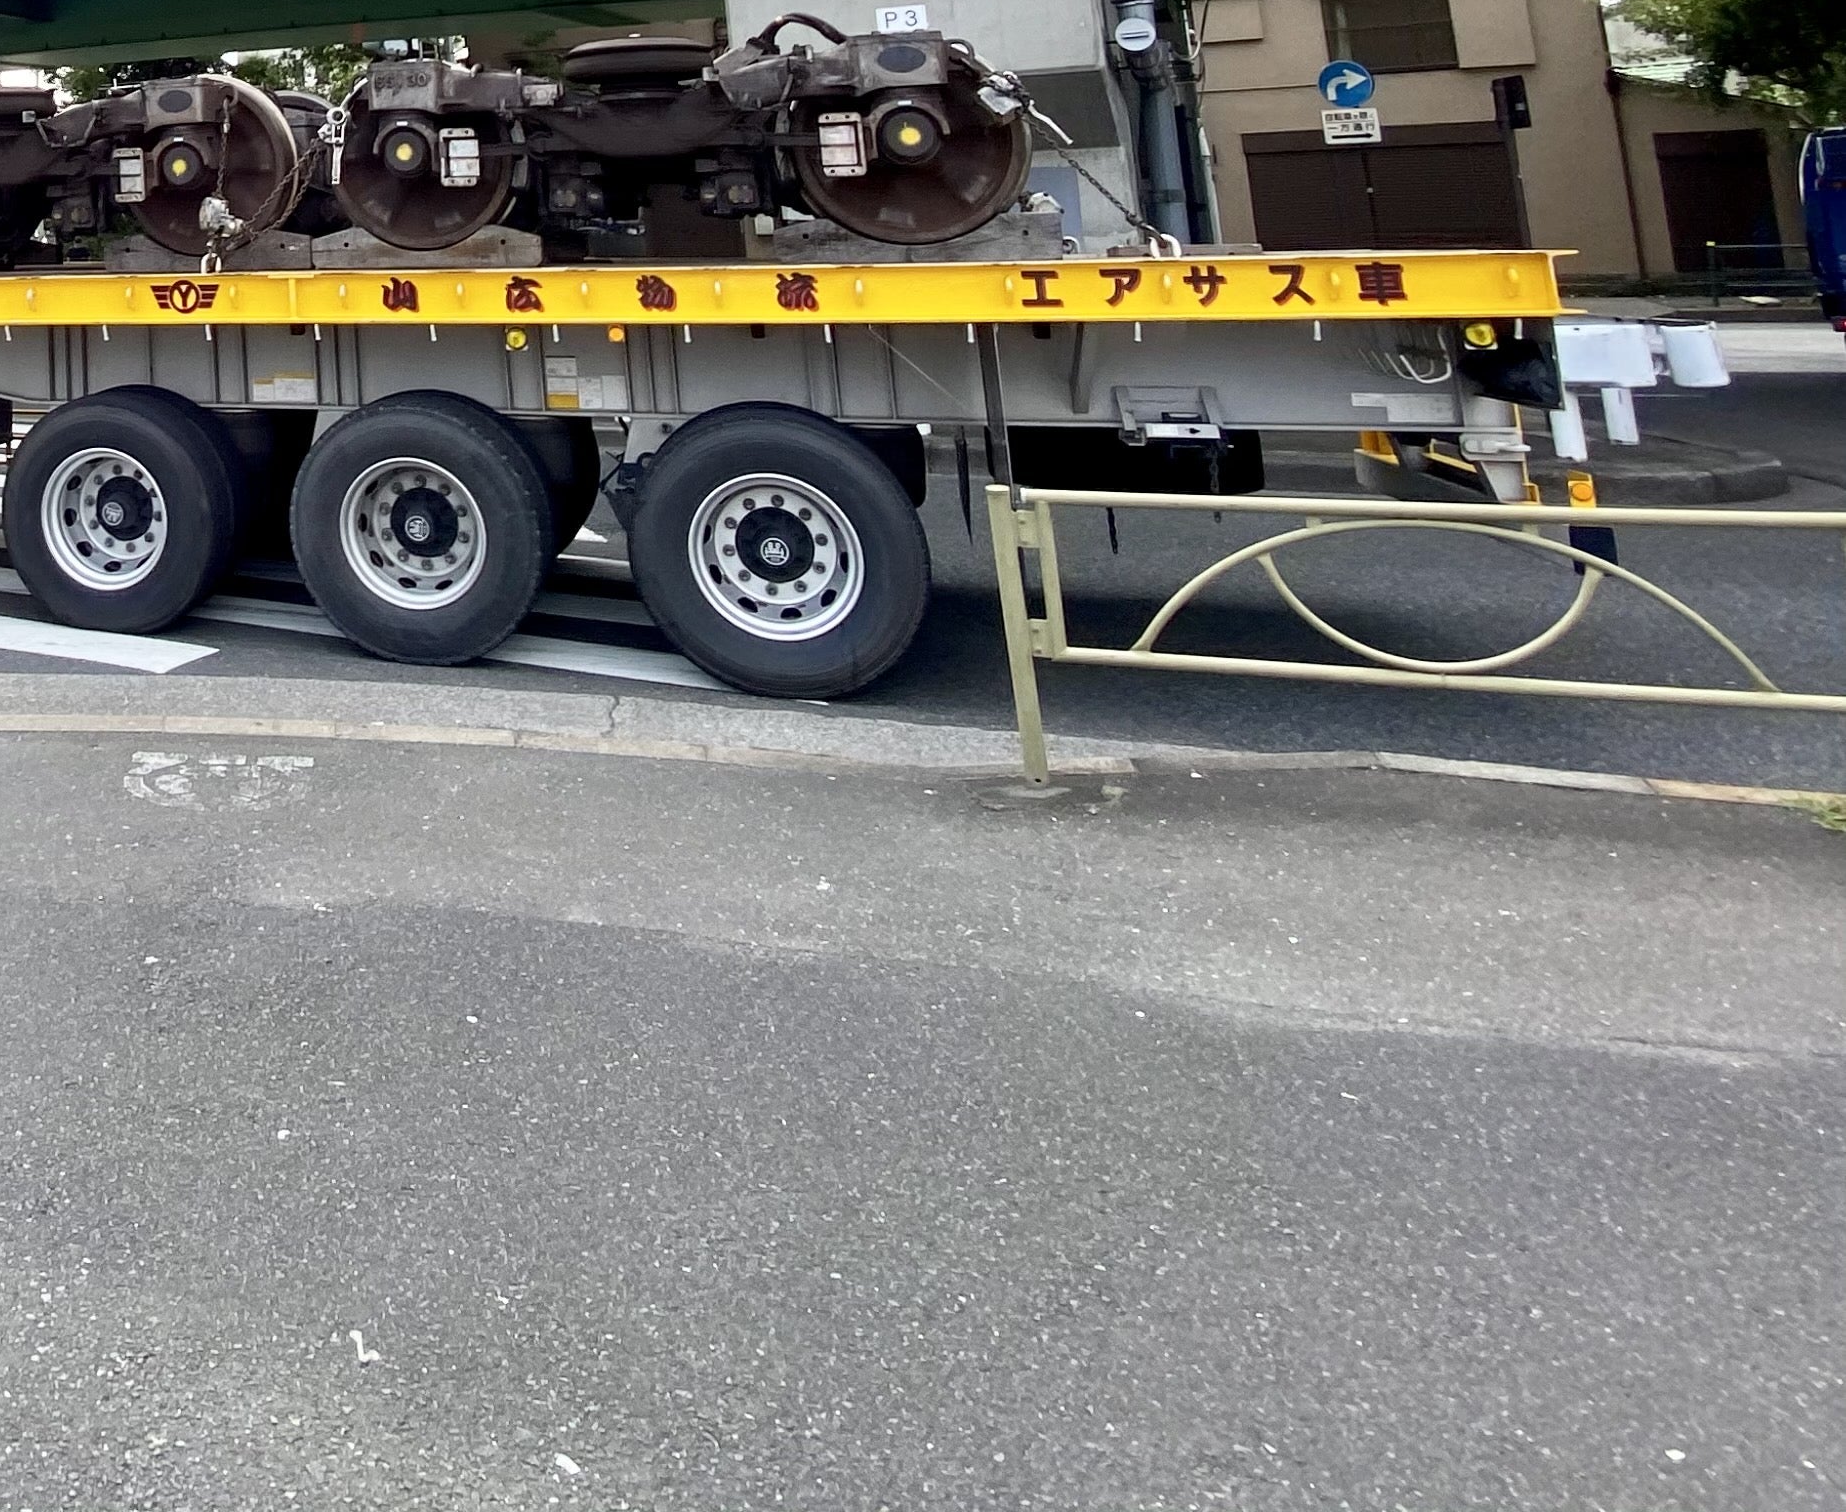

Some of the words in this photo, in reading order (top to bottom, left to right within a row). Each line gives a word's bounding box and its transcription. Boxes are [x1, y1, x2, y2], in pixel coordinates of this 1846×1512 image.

[1327, 123, 1374, 132] 一方通行
[1020, 261, 1408, 308] エアサス車
